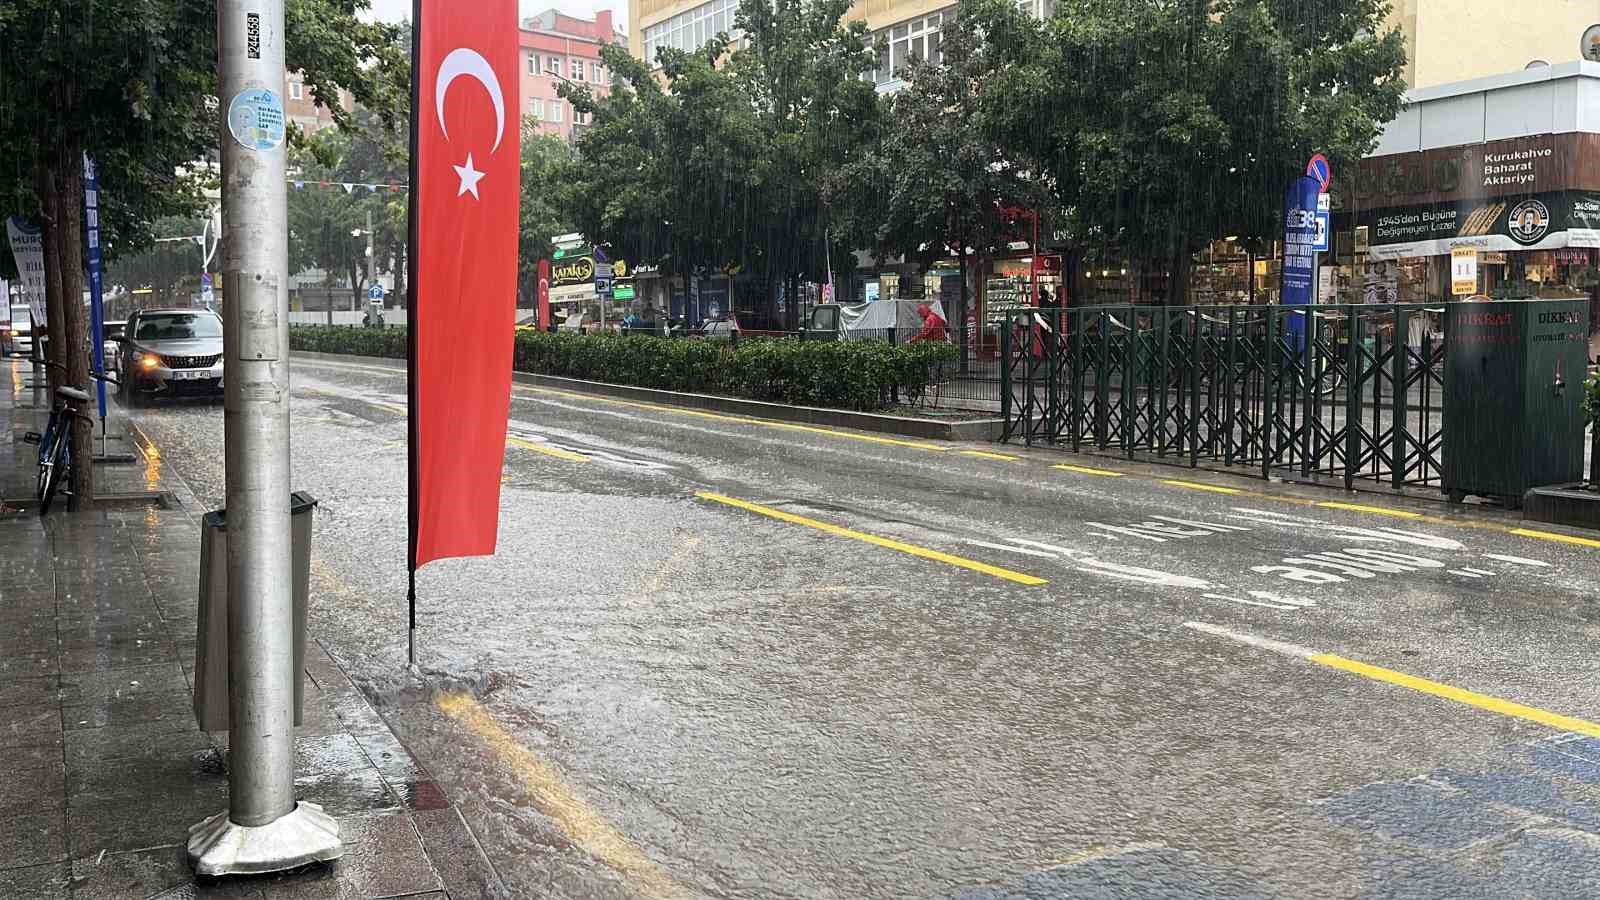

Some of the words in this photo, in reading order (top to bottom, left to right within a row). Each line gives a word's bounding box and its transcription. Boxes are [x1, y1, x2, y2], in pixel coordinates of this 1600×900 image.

[1484, 148, 1552, 163] Kurukahve
[1484, 161, 1533, 175] Baharat
[1483, 172, 1535, 186] Aktariye
[1377, 214, 1419, 227] 1945'den
[1422, 209, 1457, 223] Bugüne
